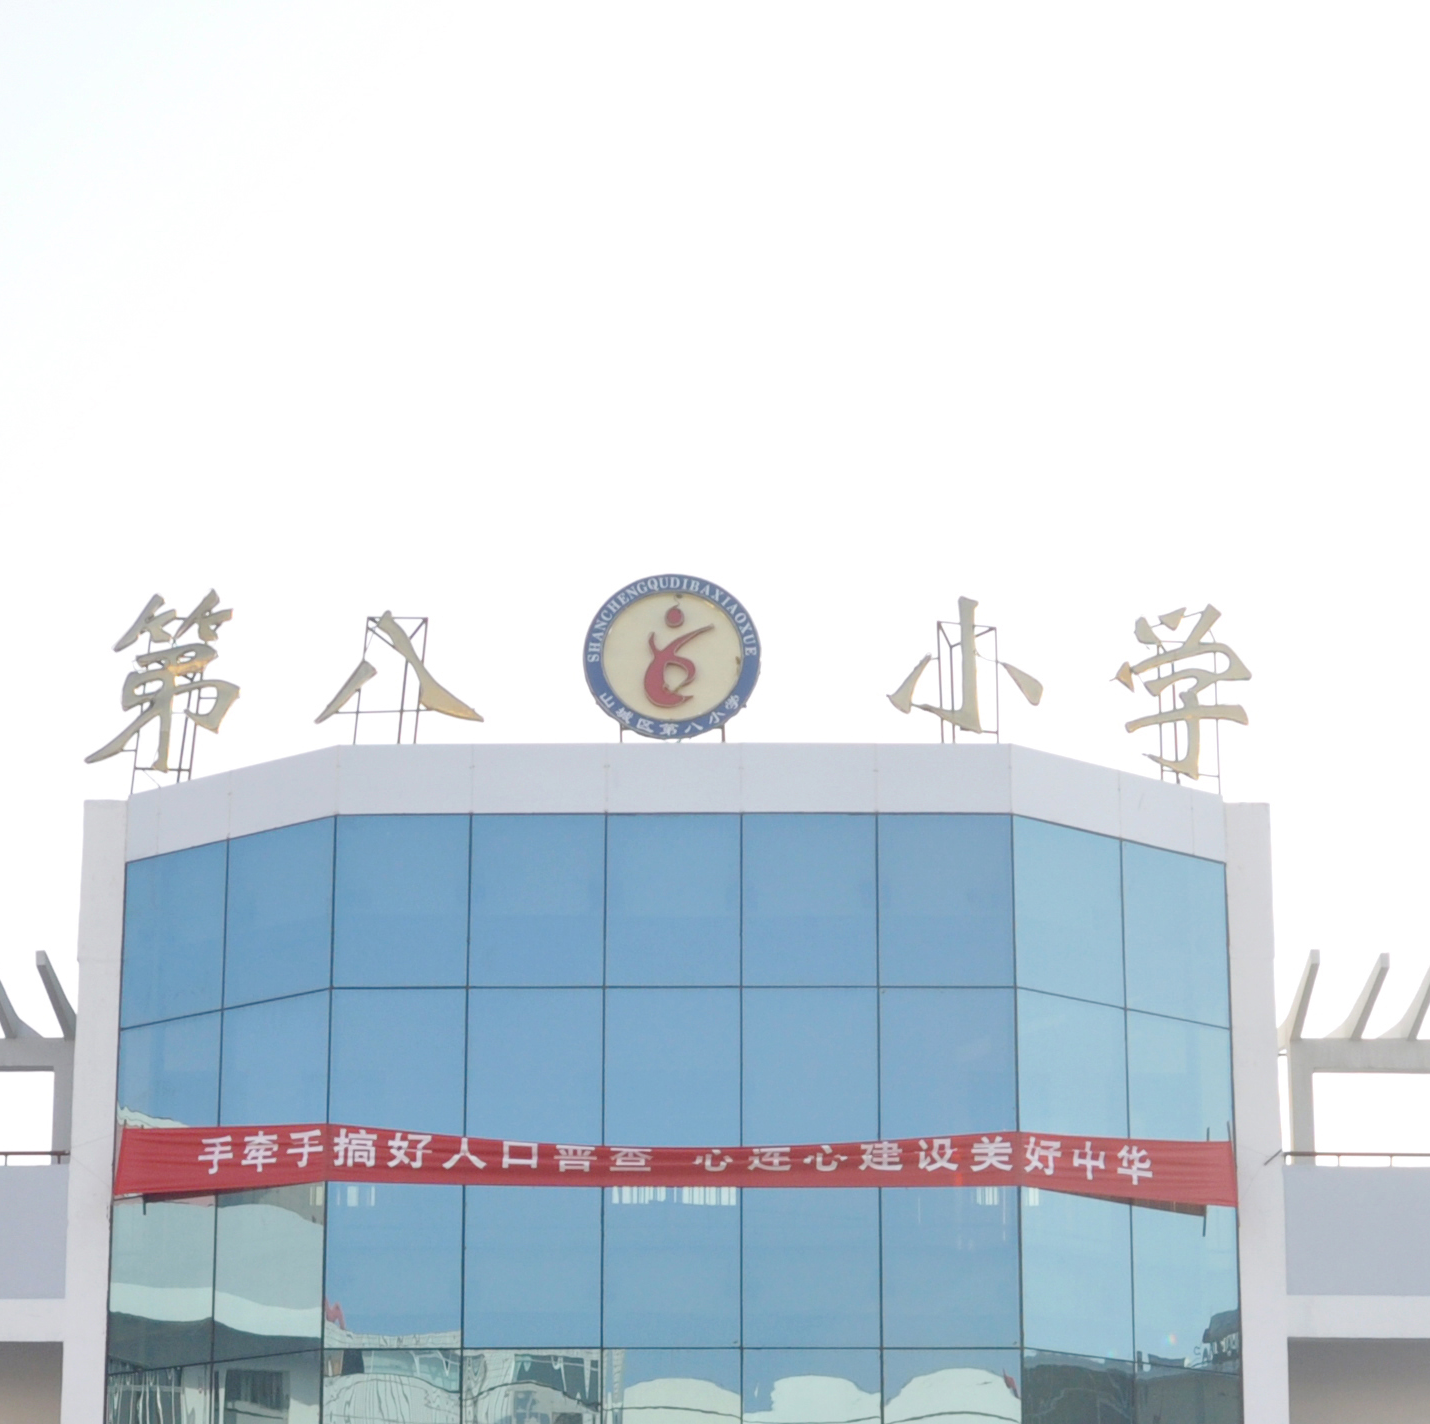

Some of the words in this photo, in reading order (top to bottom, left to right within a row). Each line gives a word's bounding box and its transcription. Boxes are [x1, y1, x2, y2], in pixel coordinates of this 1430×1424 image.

[587, 576, 757, 663] SHANCHENGQUDIBAXIAOXUE
[599, 692, 741, 737] 山城区第八小学
